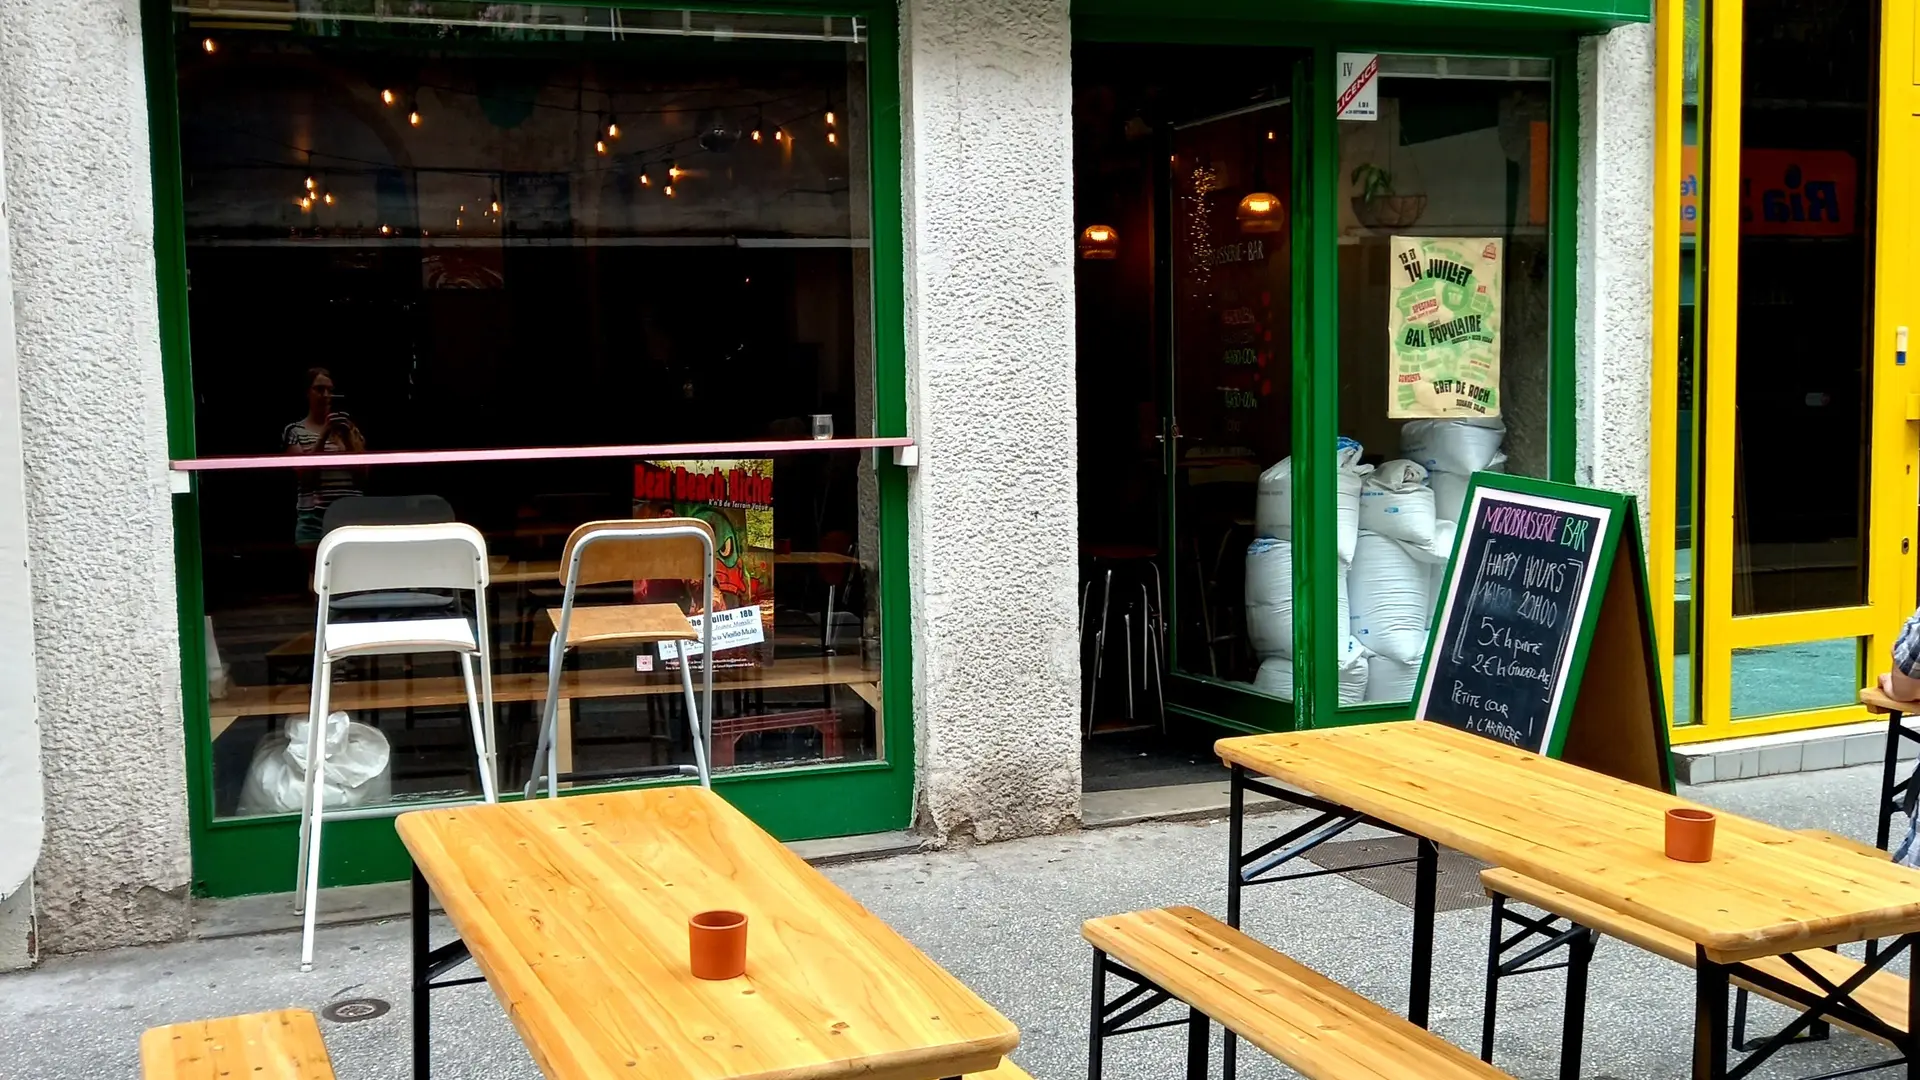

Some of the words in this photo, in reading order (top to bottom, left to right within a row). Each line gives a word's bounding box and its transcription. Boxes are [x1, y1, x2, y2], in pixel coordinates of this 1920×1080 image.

[1343, 62, 1353, 77] IV
[1247, 240, 1264, 261] BAR
[1404, 260, 1422, 282] 14
[1426, 258, 1473, 287] JUILLET
[1404, 328, 1426, 347] BAL
[1429, 314, 1481, 345] POPULAIRE
[1455, 380, 1466, 395] DE
[1468, 384, 1491, 403] ROCH
[634, 463, 671, 500] Beat
[675, 465, 725, 503] Beach
[723, 499, 731, 508] de
[732, 500, 751, 510] Terrain
[1481, 505, 1562, 543] MICROBRASSERIE
[1560, 516, 1589, 553] BAR
[1486, 552, 1522, 581] HAPPY
[1522, 555, 1567, 593] HOURS
[711, 612, 733, 624] uillet
[739, 609, 753, 619] 18h
[1517, 591, 1558, 629] 20H00
[1471, 653, 1497, 676] 2€
